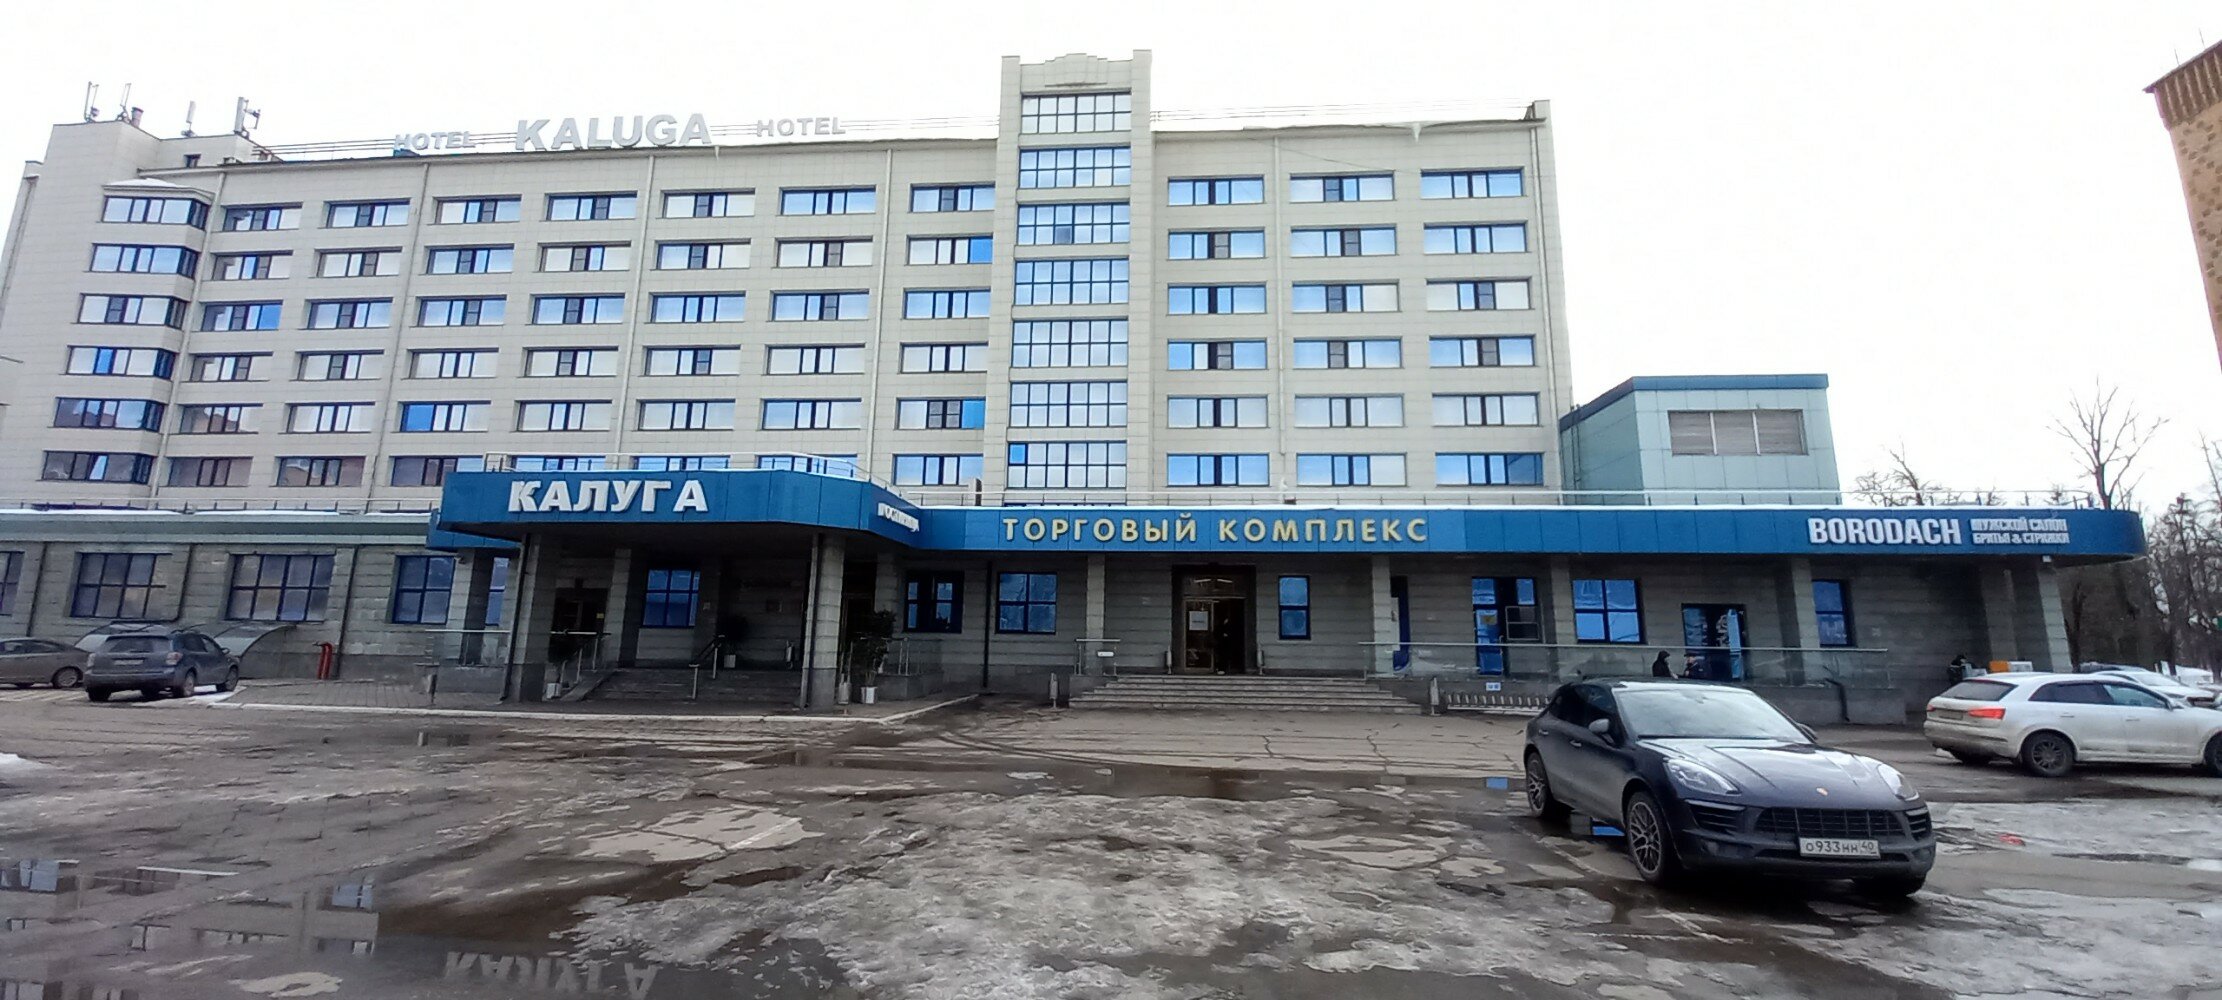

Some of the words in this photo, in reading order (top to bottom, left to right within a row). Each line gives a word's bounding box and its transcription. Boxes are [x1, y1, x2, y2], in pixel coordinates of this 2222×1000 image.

[394, 131, 475, 150] HOTEL
[515, 113, 711, 150] KALUGA
[757, 117, 846, 137] HOTEL
[508, 480, 708, 512] КАЛУГА
[1003, 513, 1197, 542] ТОРГОВЫЙ
[1219, 517, 1427, 542] КОМПЛЕКС
[1808, 518, 1962, 544] BORODACH
[2029, 519, 2067, 531] САЛОН
